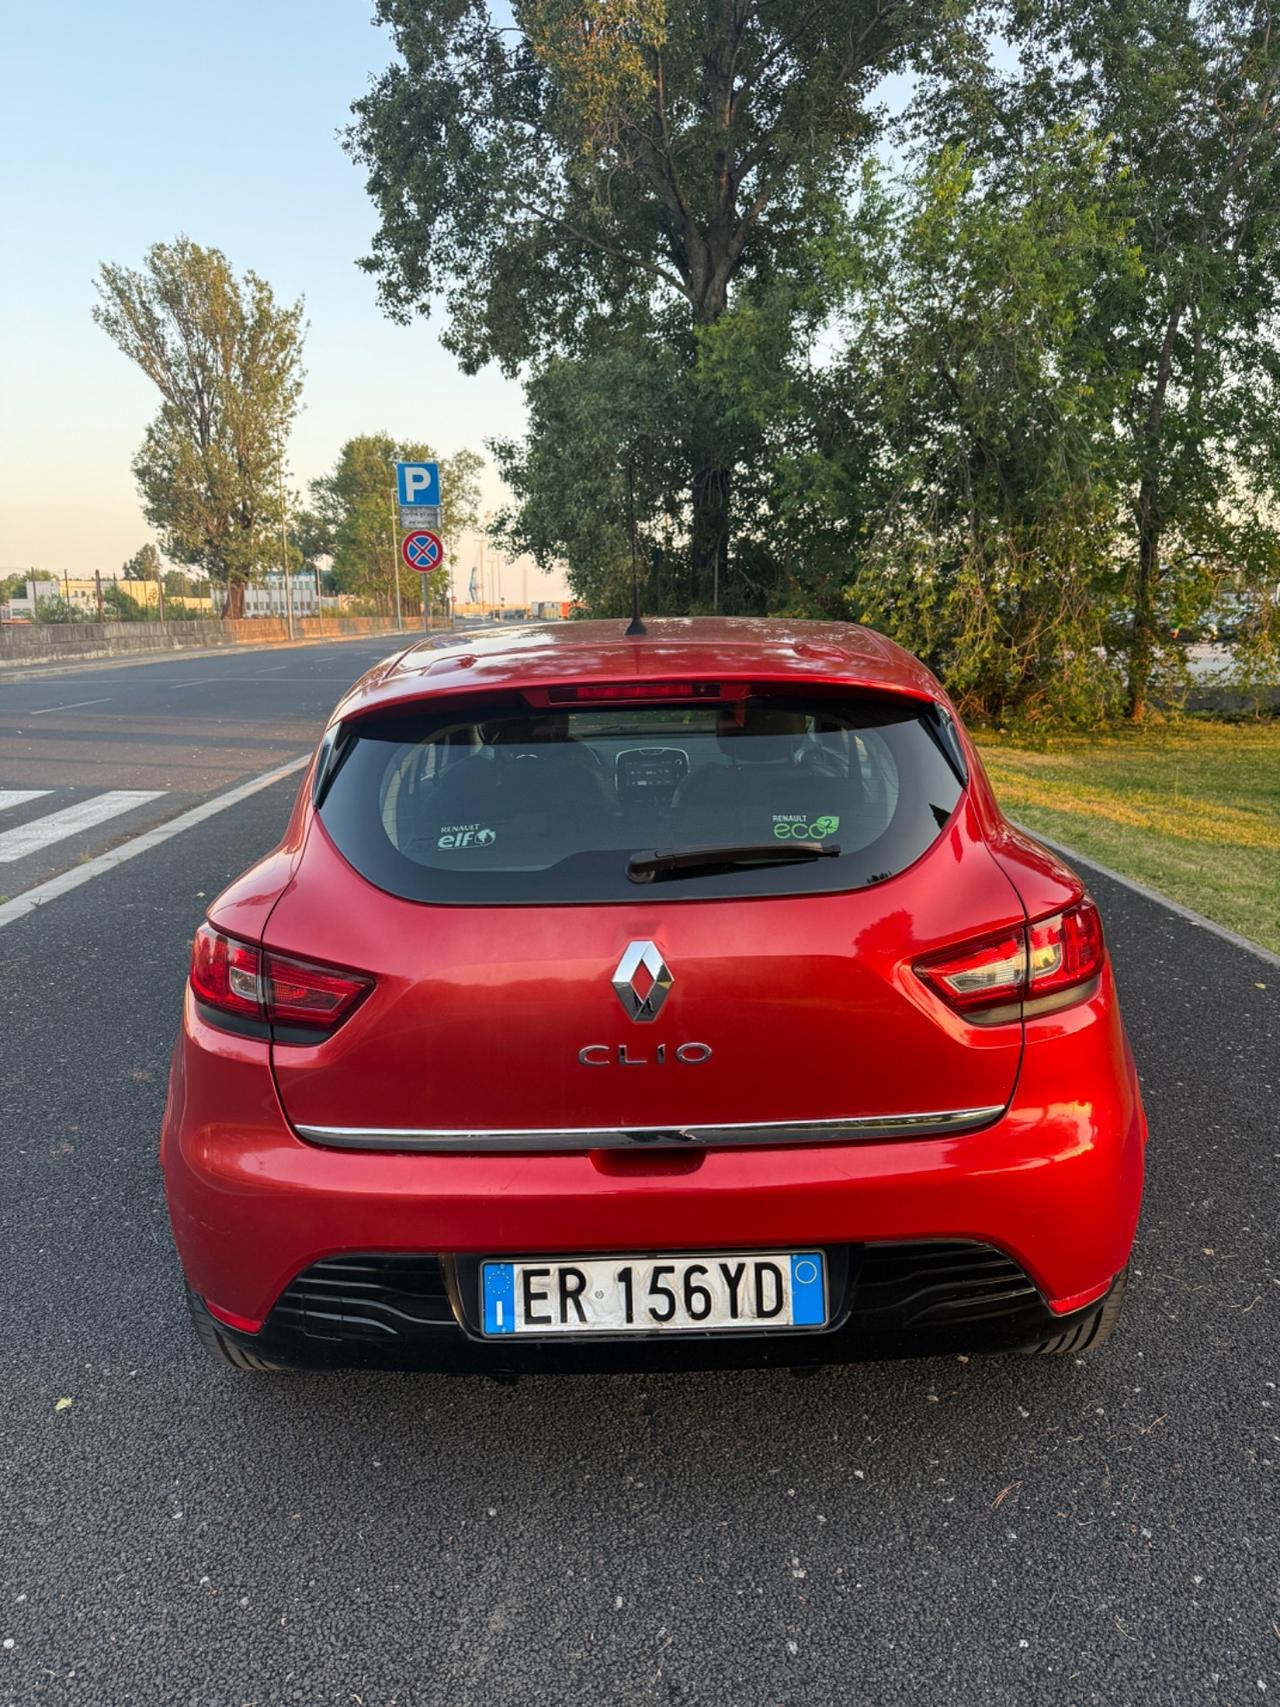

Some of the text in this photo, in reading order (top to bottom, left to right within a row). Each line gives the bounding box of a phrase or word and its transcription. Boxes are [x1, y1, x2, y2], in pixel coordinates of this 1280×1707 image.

[404, 467, 432, 502] P
[437, 831, 475, 848] elf
[440, 823, 480, 833] RENAULT
[578, 1042, 713, 1065] CLIO
[522, 1261, 785, 1325] ER 156YD
